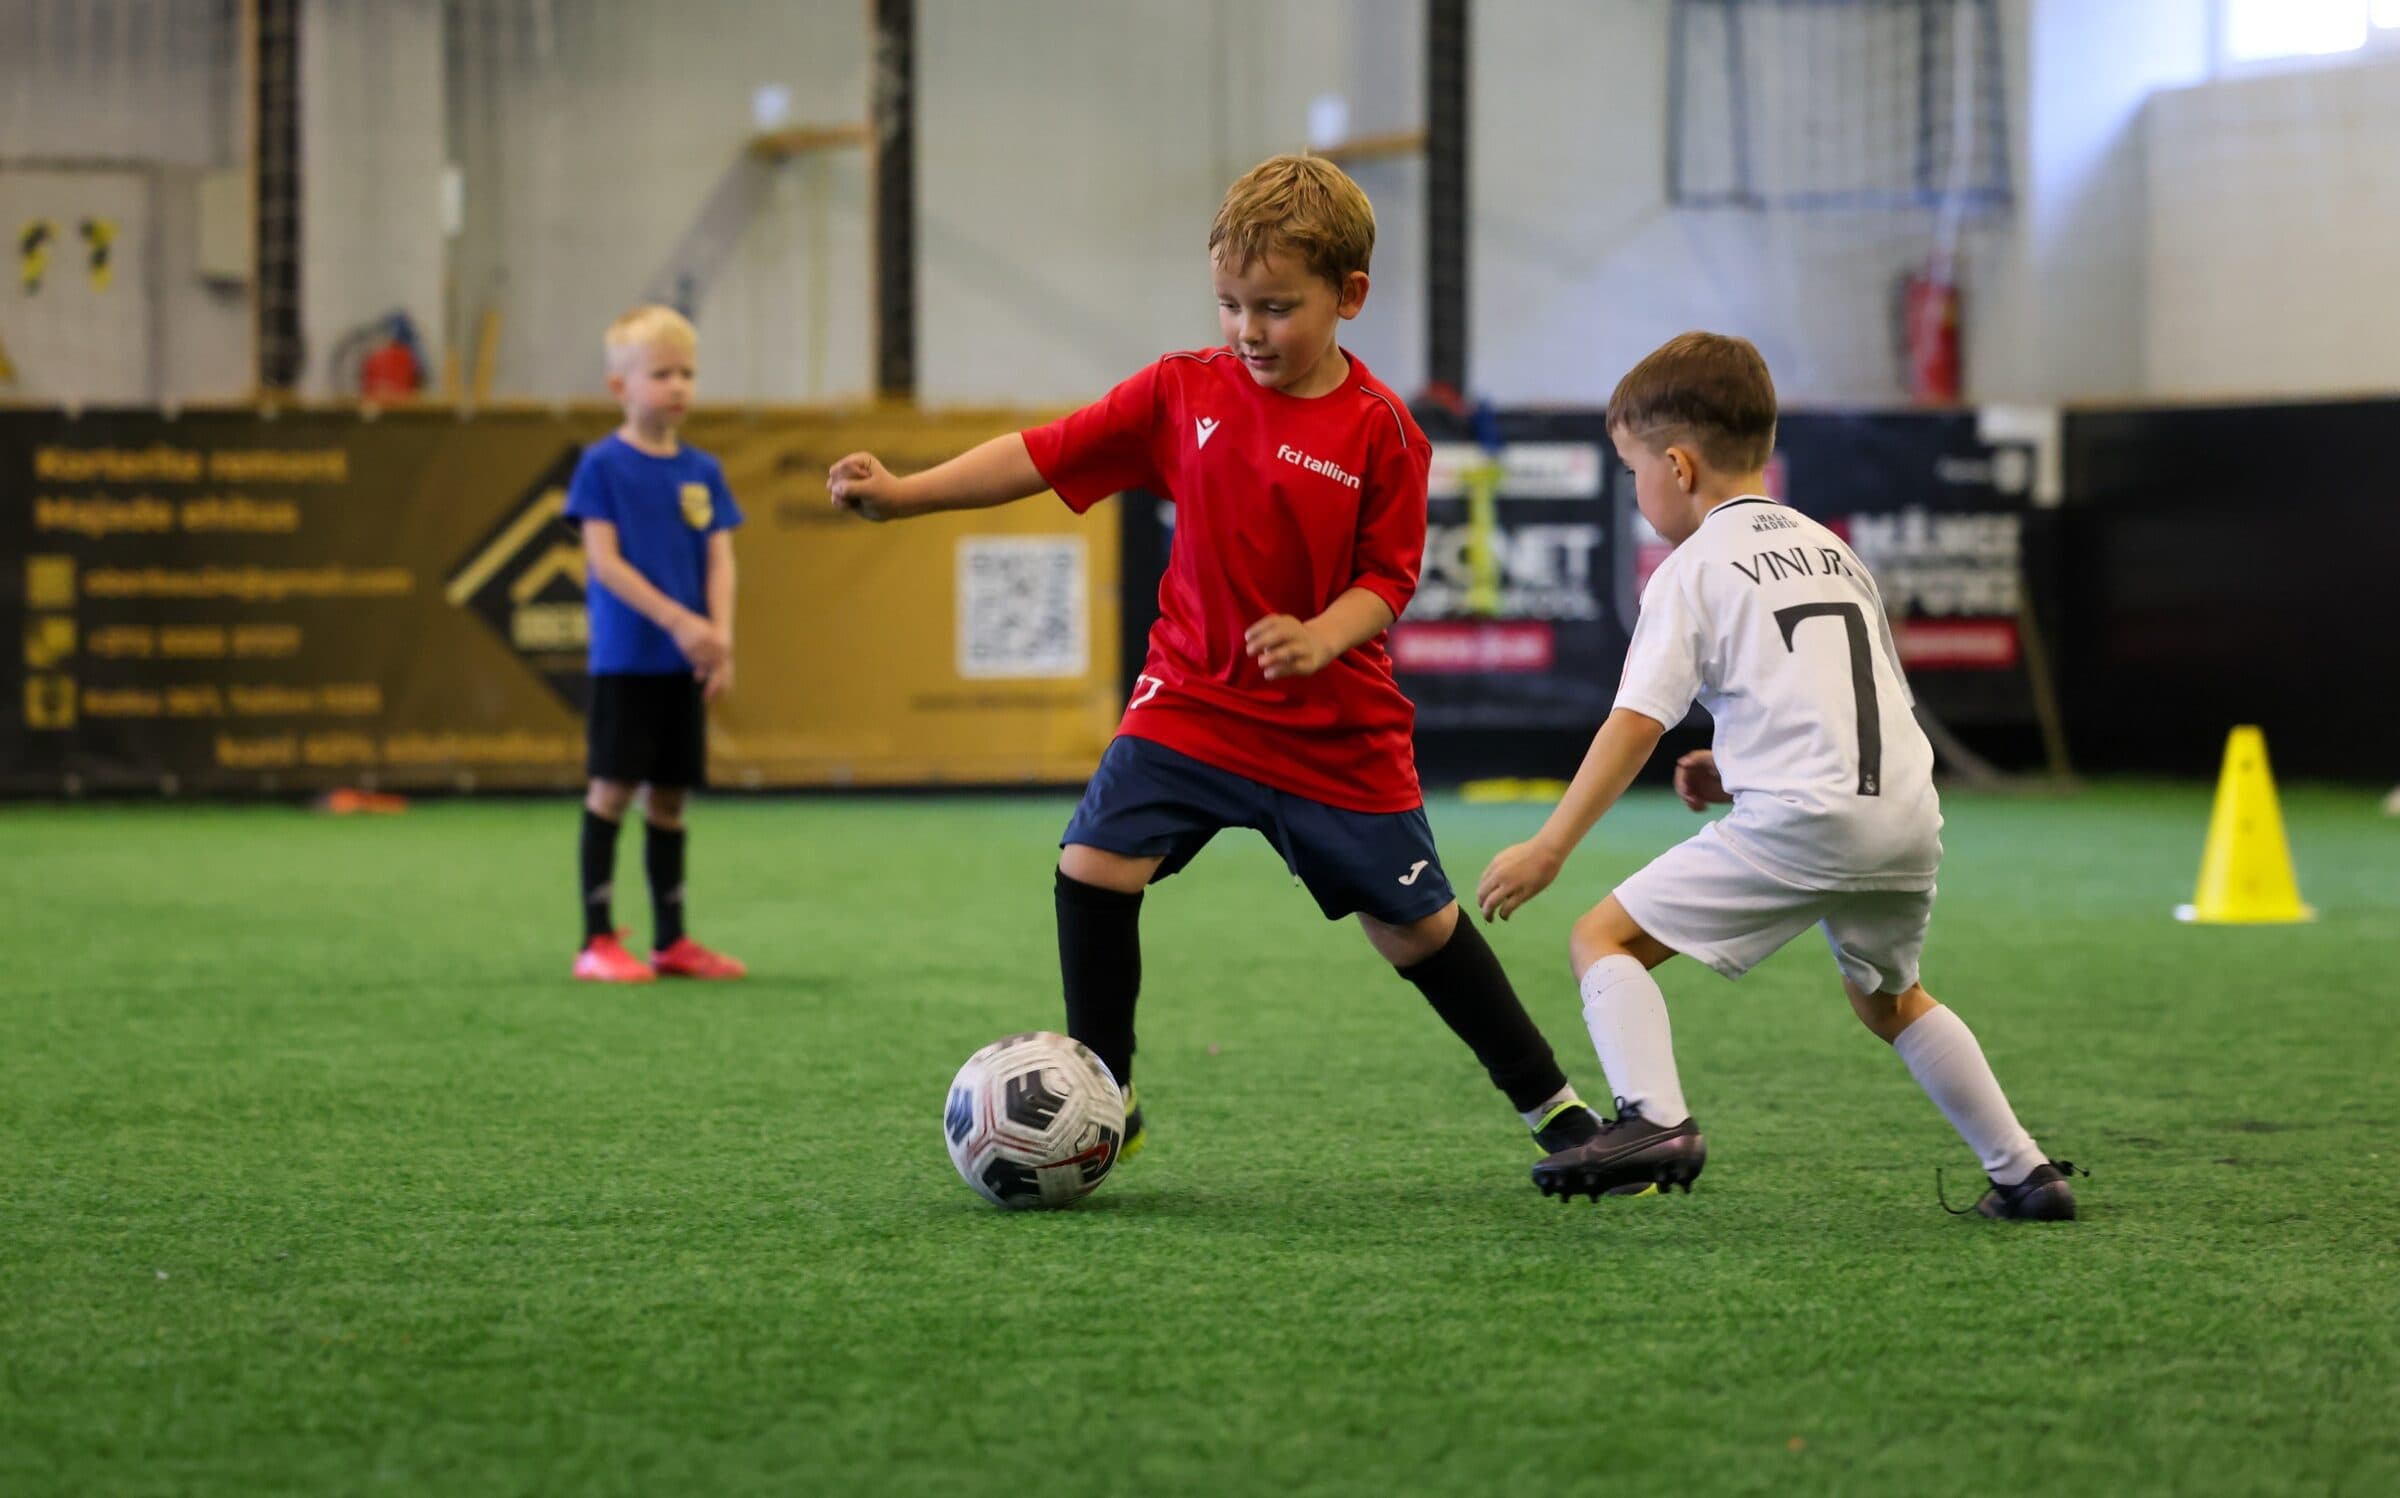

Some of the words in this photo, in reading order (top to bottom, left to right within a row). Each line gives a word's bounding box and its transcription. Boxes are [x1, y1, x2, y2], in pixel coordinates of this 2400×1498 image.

[1277, 444, 1303, 465] fci
[1302, 455, 1361, 490] tallinn
[1731, 547, 1813, 585] VINI
[1773, 602, 1882, 797] 7
